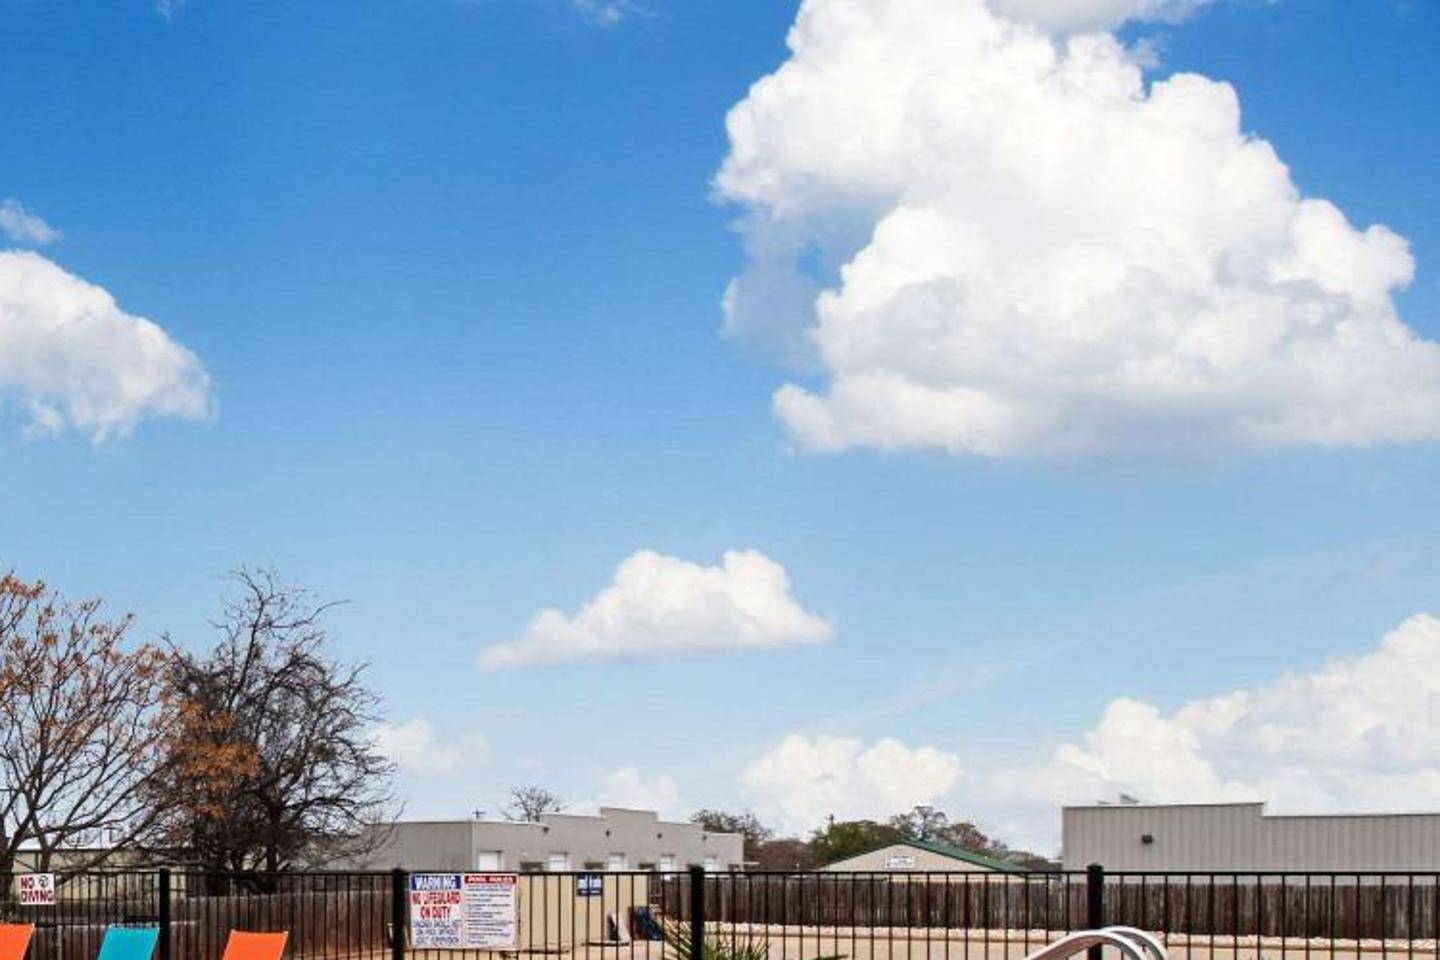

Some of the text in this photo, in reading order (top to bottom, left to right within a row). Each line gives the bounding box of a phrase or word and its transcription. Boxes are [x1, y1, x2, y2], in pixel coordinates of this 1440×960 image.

[20, 876, 36, 889] NO
[414, 875, 457, 890] WARNING
[20, 890, 54, 902] DIVING
[420, 906, 452, 919] ON DUTY
